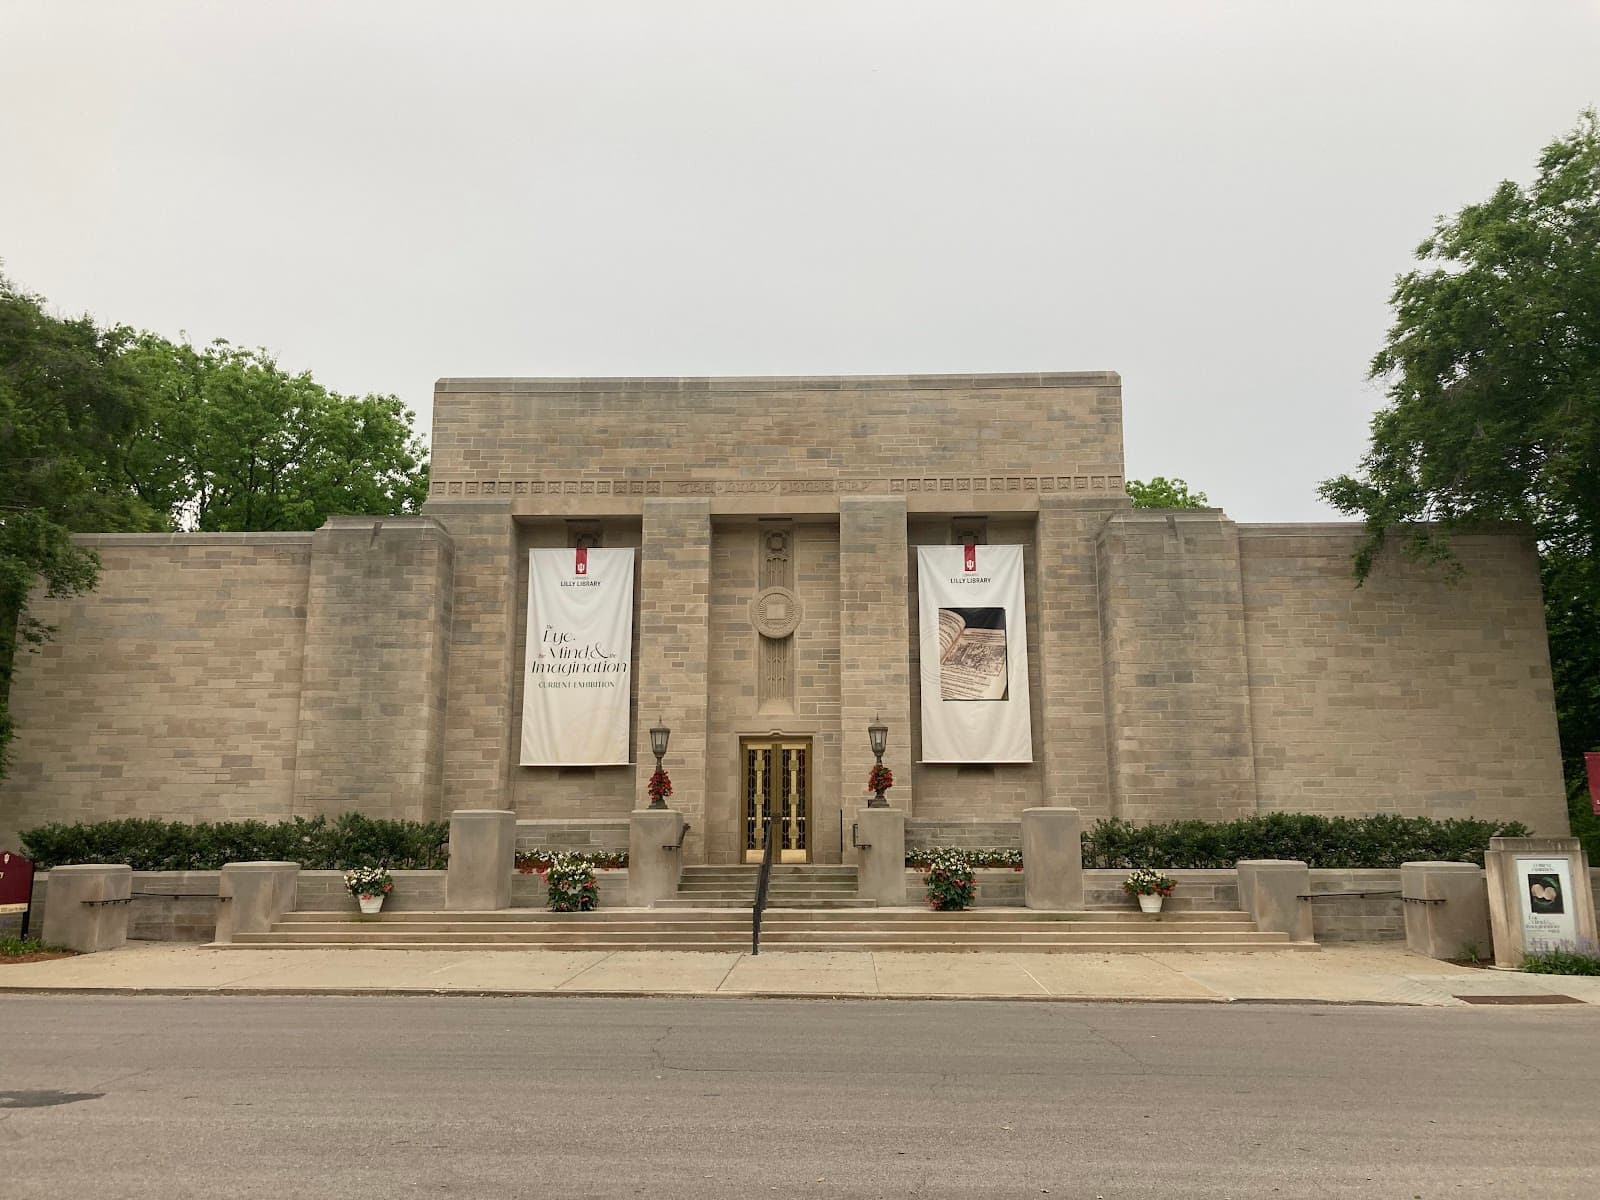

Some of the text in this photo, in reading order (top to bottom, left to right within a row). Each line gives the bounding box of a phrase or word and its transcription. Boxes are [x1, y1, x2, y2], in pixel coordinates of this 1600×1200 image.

[590, 641, 609, 659] &
[532, 661, 627, 676] Imagination
[574, 681, 615, 689] EXHIBITION
